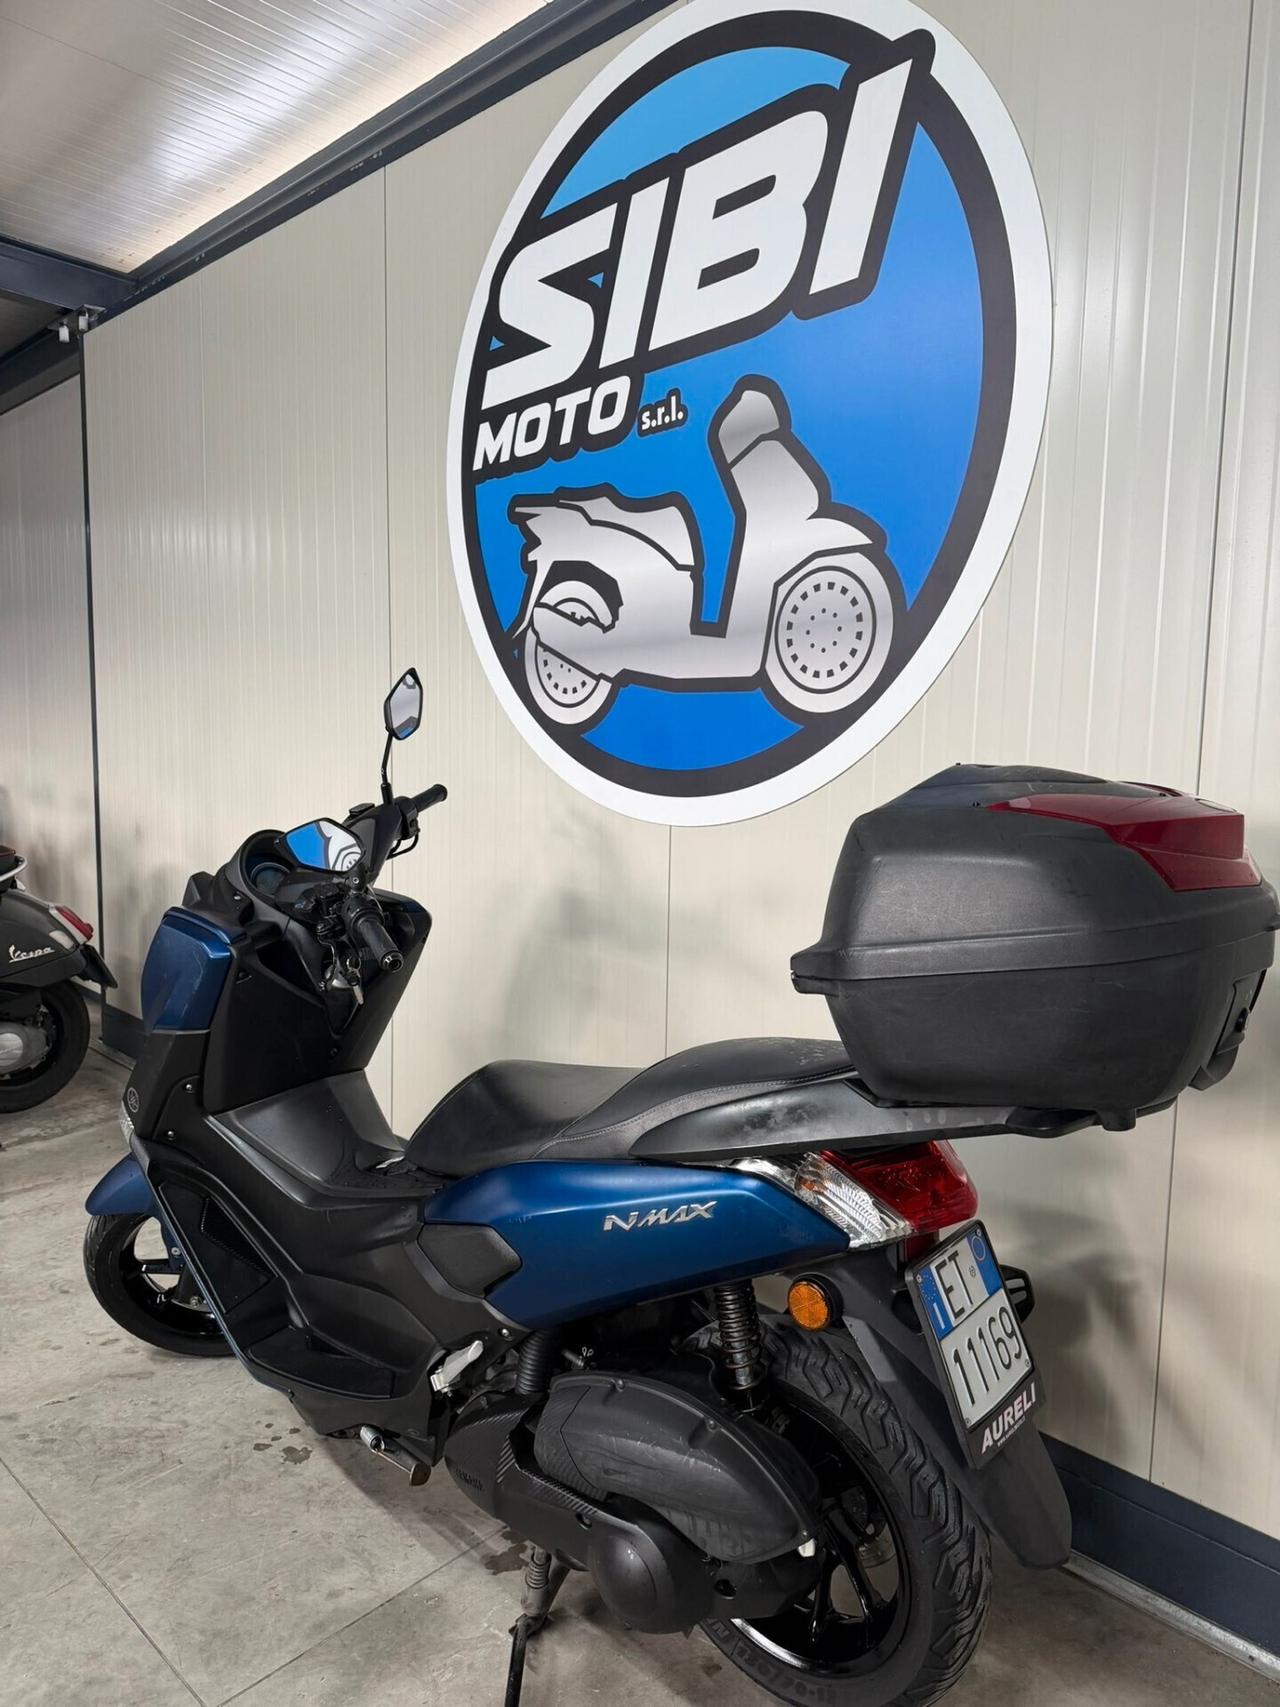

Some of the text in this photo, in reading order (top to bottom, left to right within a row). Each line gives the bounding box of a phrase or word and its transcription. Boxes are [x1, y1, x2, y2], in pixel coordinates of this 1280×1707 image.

[481, 59, 913, 410] SIBI
[472, 375, 684, 471] MOTO s.r.l.
[9, 945, 55, 963] Vespa
[932, 1249, 974, 1330] I ET
[953, 1306, 1022, 1406] 11169
[981, 1383, 1036, 1454] AURELI
